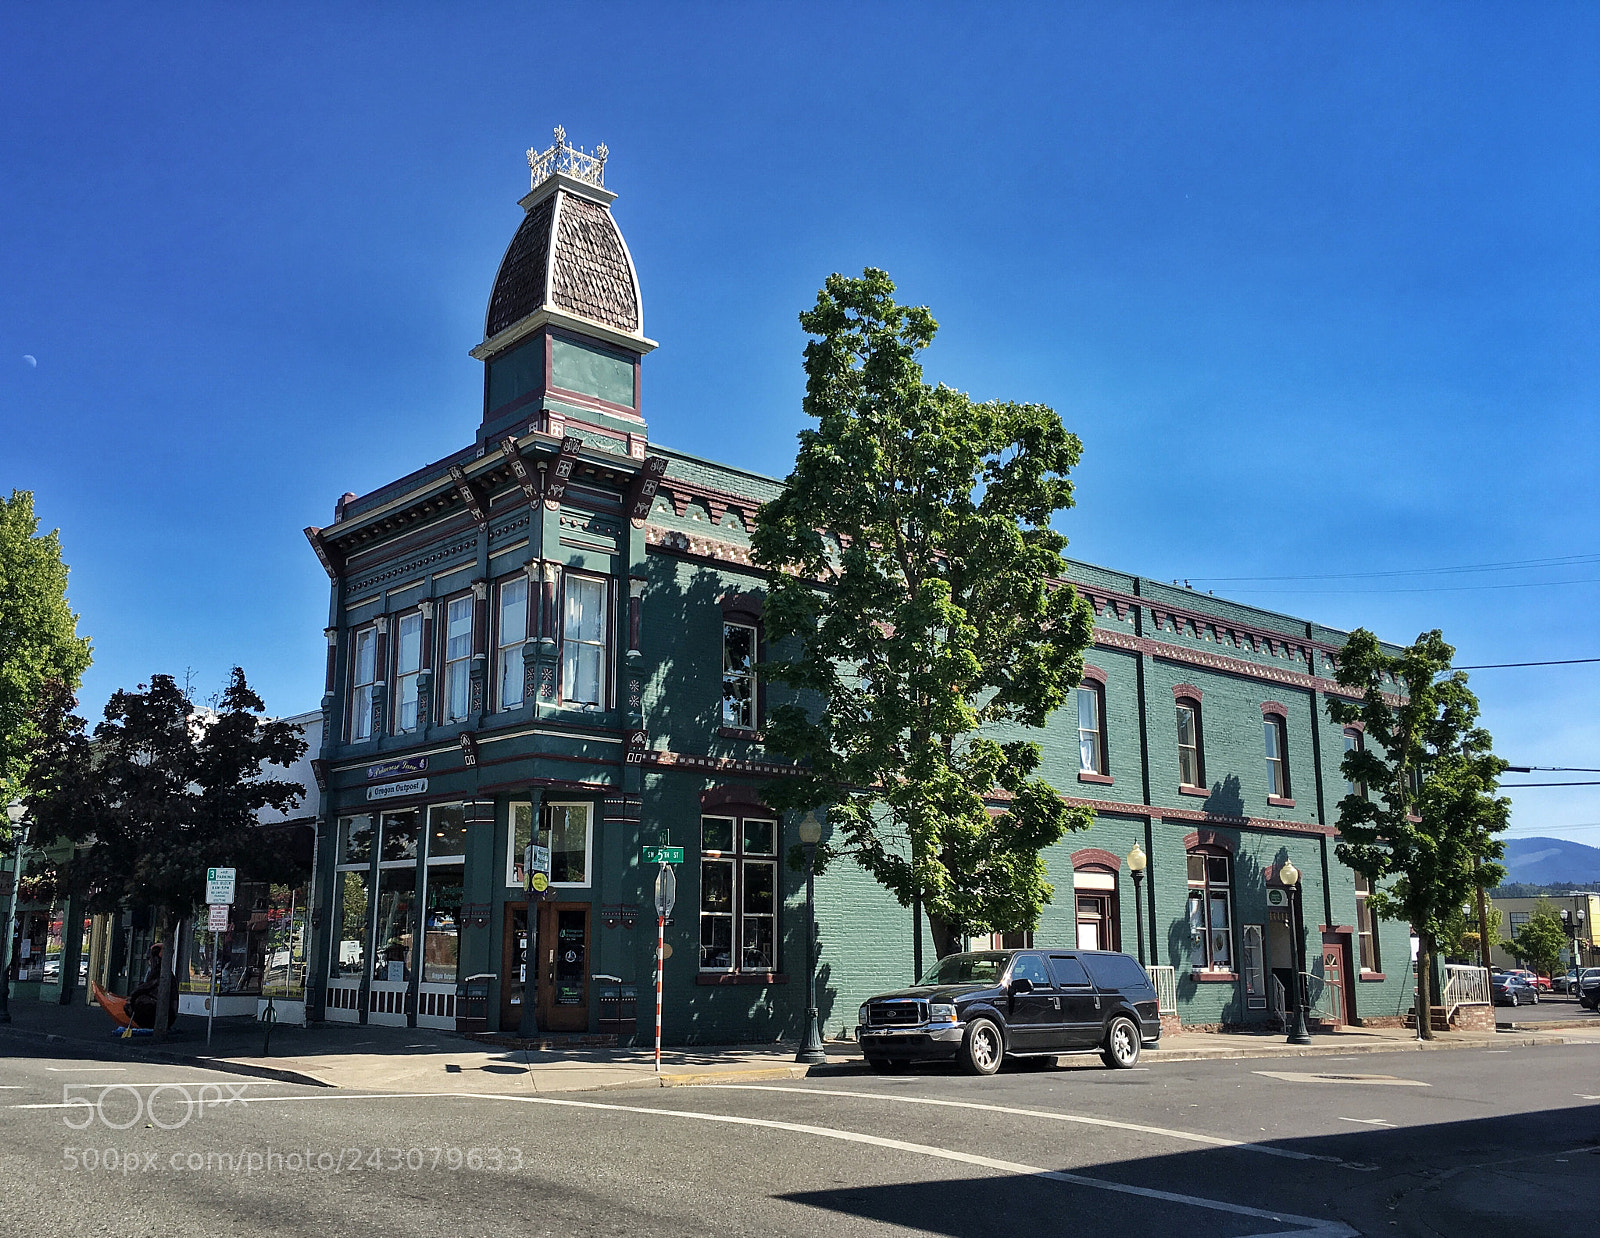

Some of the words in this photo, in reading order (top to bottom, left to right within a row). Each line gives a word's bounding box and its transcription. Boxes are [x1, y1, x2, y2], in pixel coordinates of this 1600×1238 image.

[374, 787, 395, 796] Oregon
[395, 782, 419, 792] Outpost
[657, 849, 670, 861] 5TH
[673, 851, 679, 859] ST
[209, 870, 215, 879] 3
